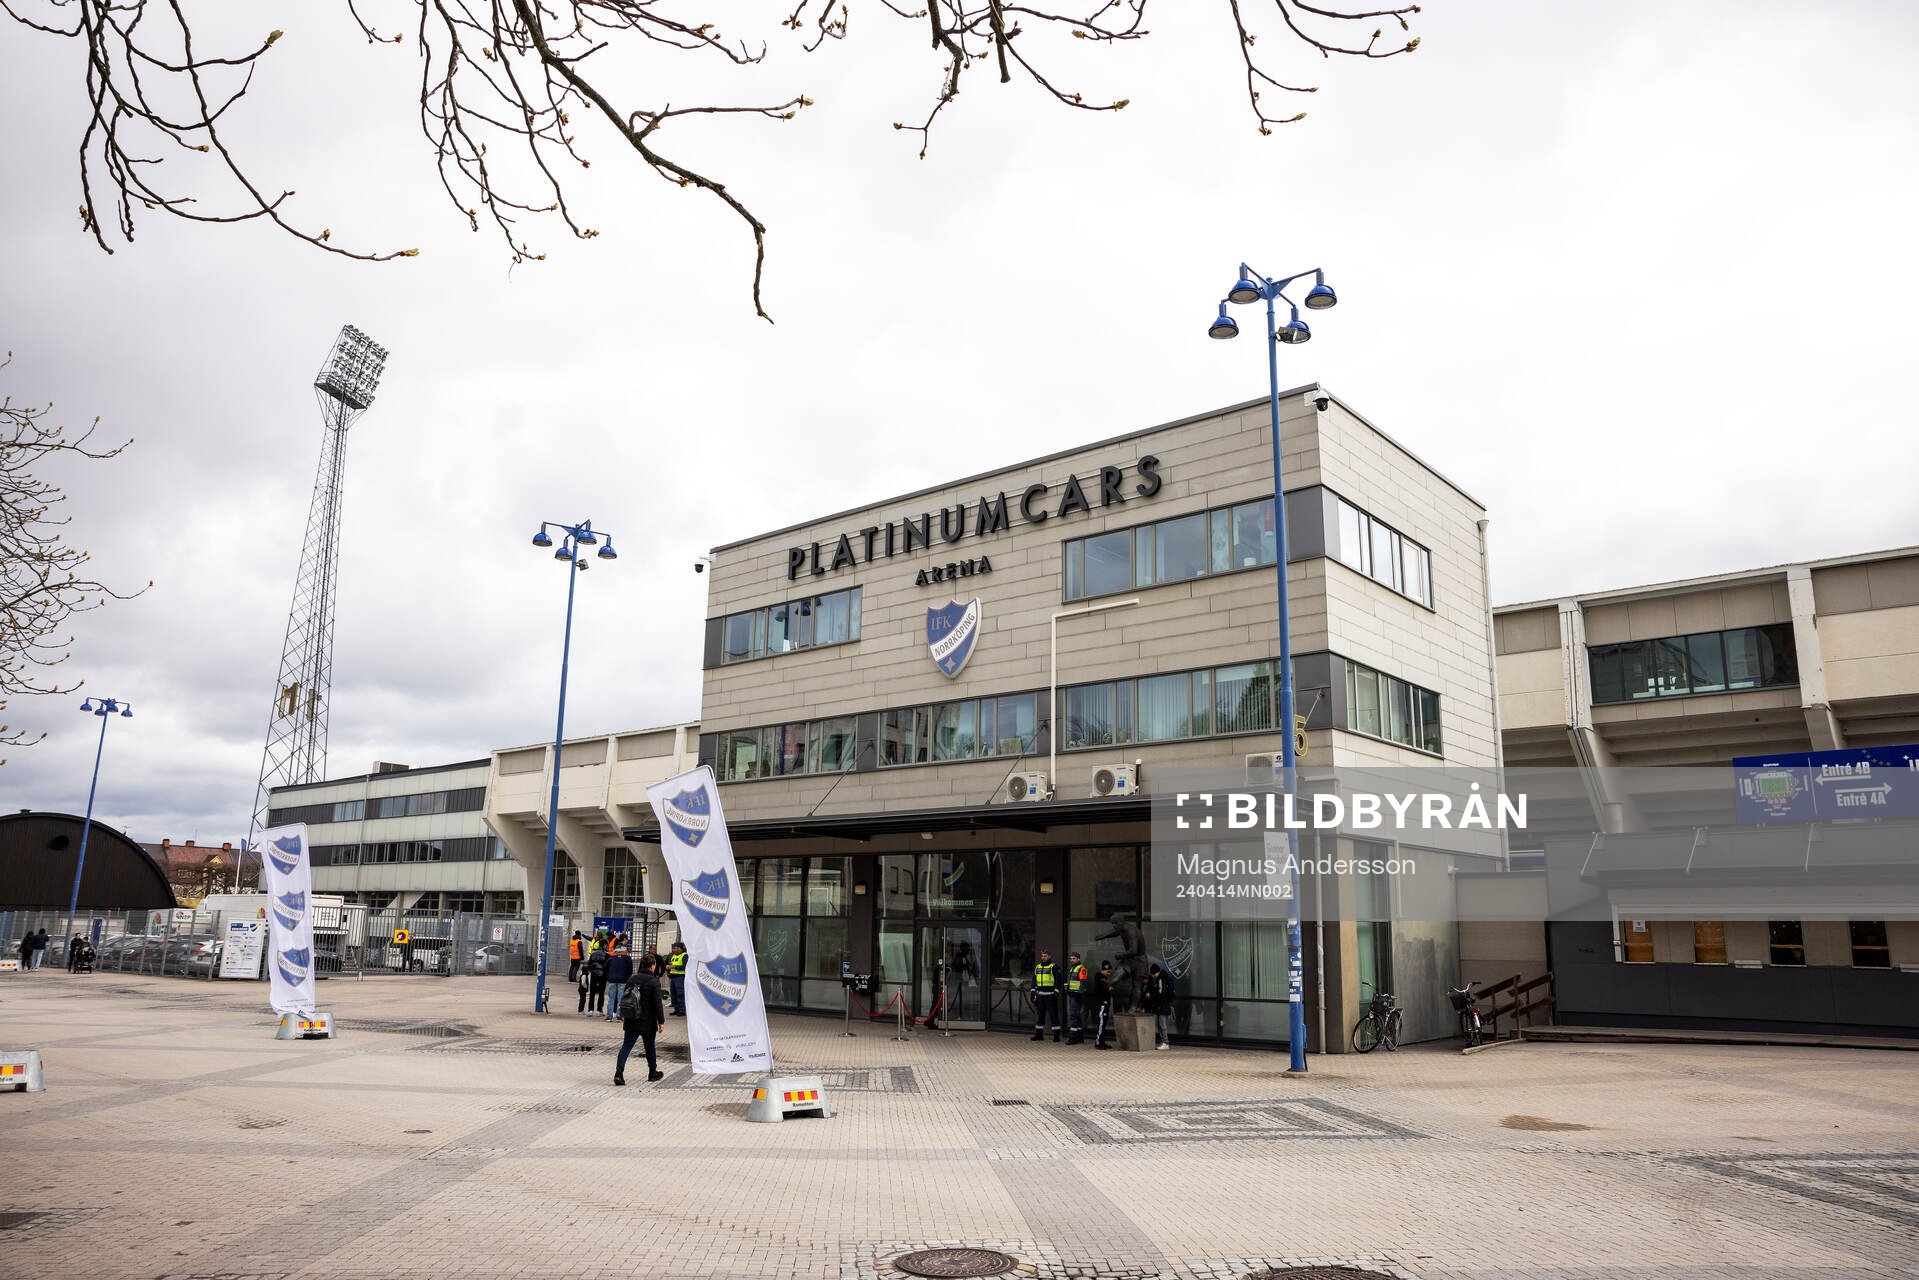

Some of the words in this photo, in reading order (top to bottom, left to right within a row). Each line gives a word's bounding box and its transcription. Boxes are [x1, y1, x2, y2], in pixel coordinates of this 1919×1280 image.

[787, 454, 1162, 581] PLATINUMCARS
[915, 555, 993, 586] ARENA
[930, 615, 952, 631] IFK
[934, 612, 976, 657] NORRKÖPING
[1821, 764, 1851, 777] Entré
[1855, 761, 1871, 775] 4B
[1836, 792, 1867, 807] Entré
[1870, 791, 1887, 805] 4A
